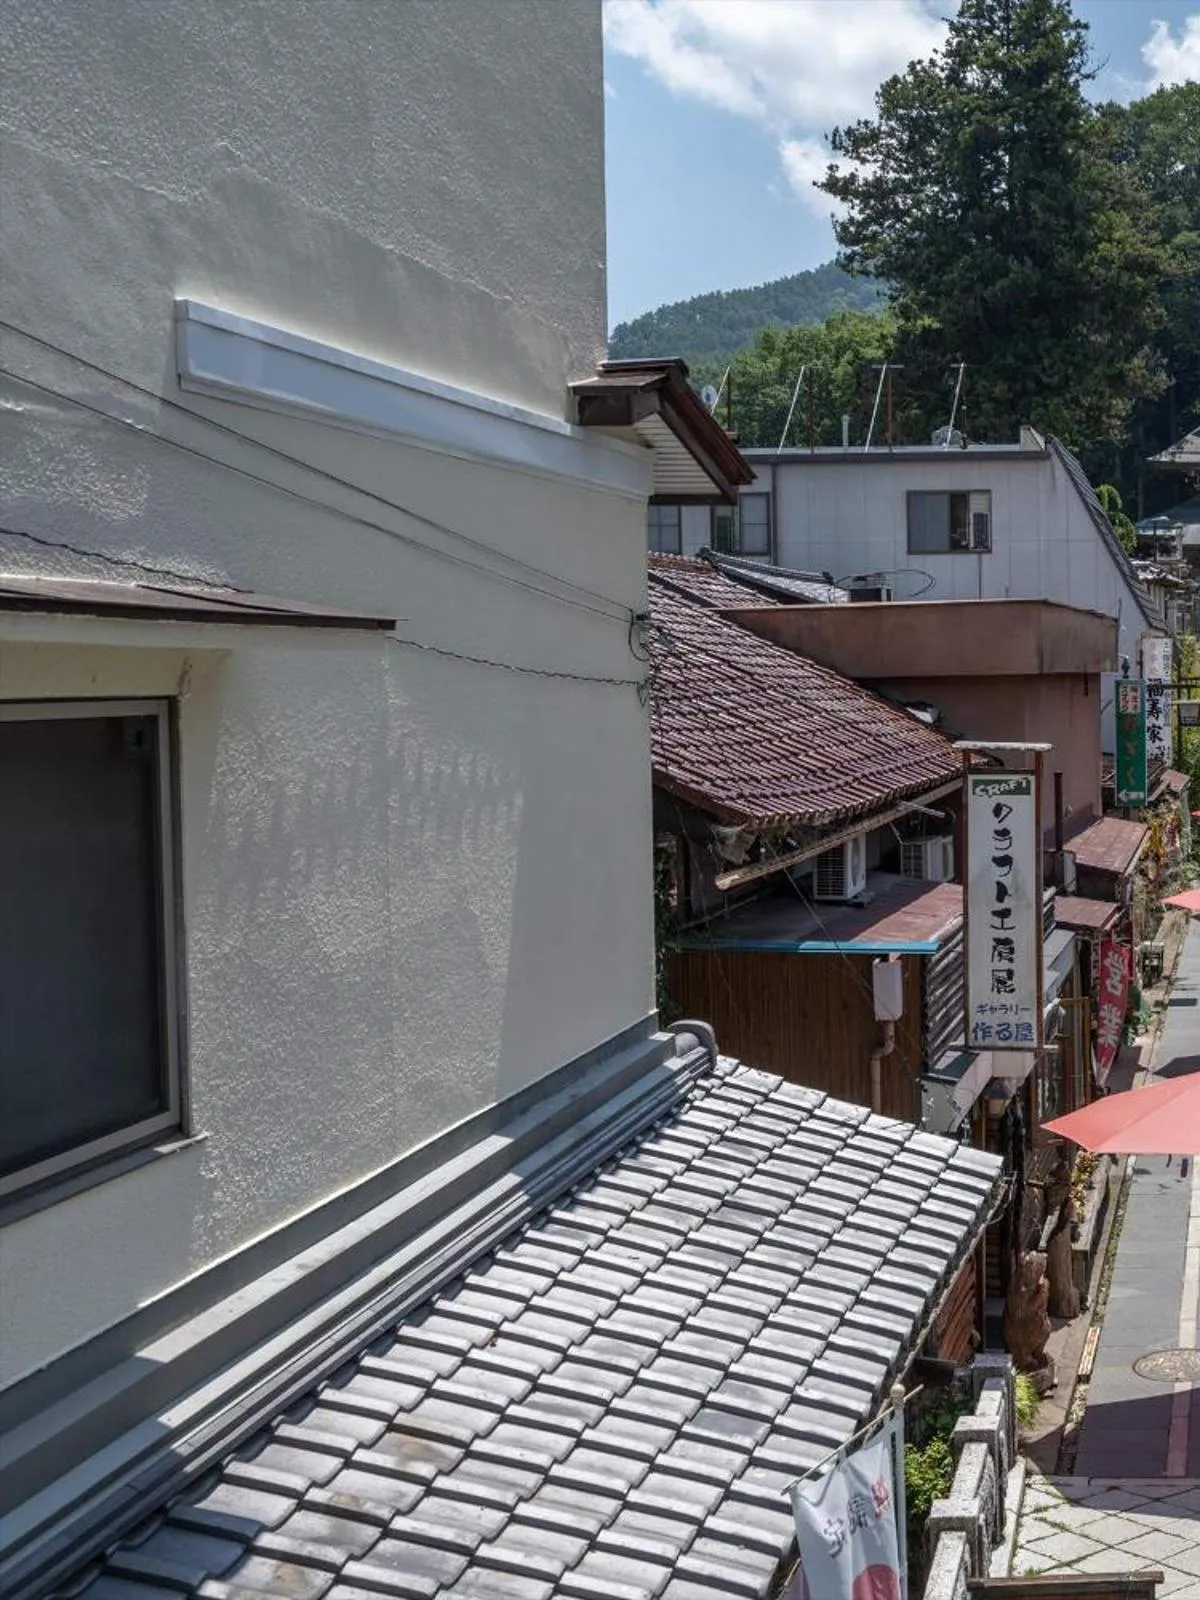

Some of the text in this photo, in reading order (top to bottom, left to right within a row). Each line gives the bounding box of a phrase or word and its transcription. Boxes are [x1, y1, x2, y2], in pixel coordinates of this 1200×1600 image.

[974, 777, 1029, 797] CRAFT
[976, 1003, 1031, 1015] ギャラリー
[972, 1022, 1035, 1042] 作る屋
